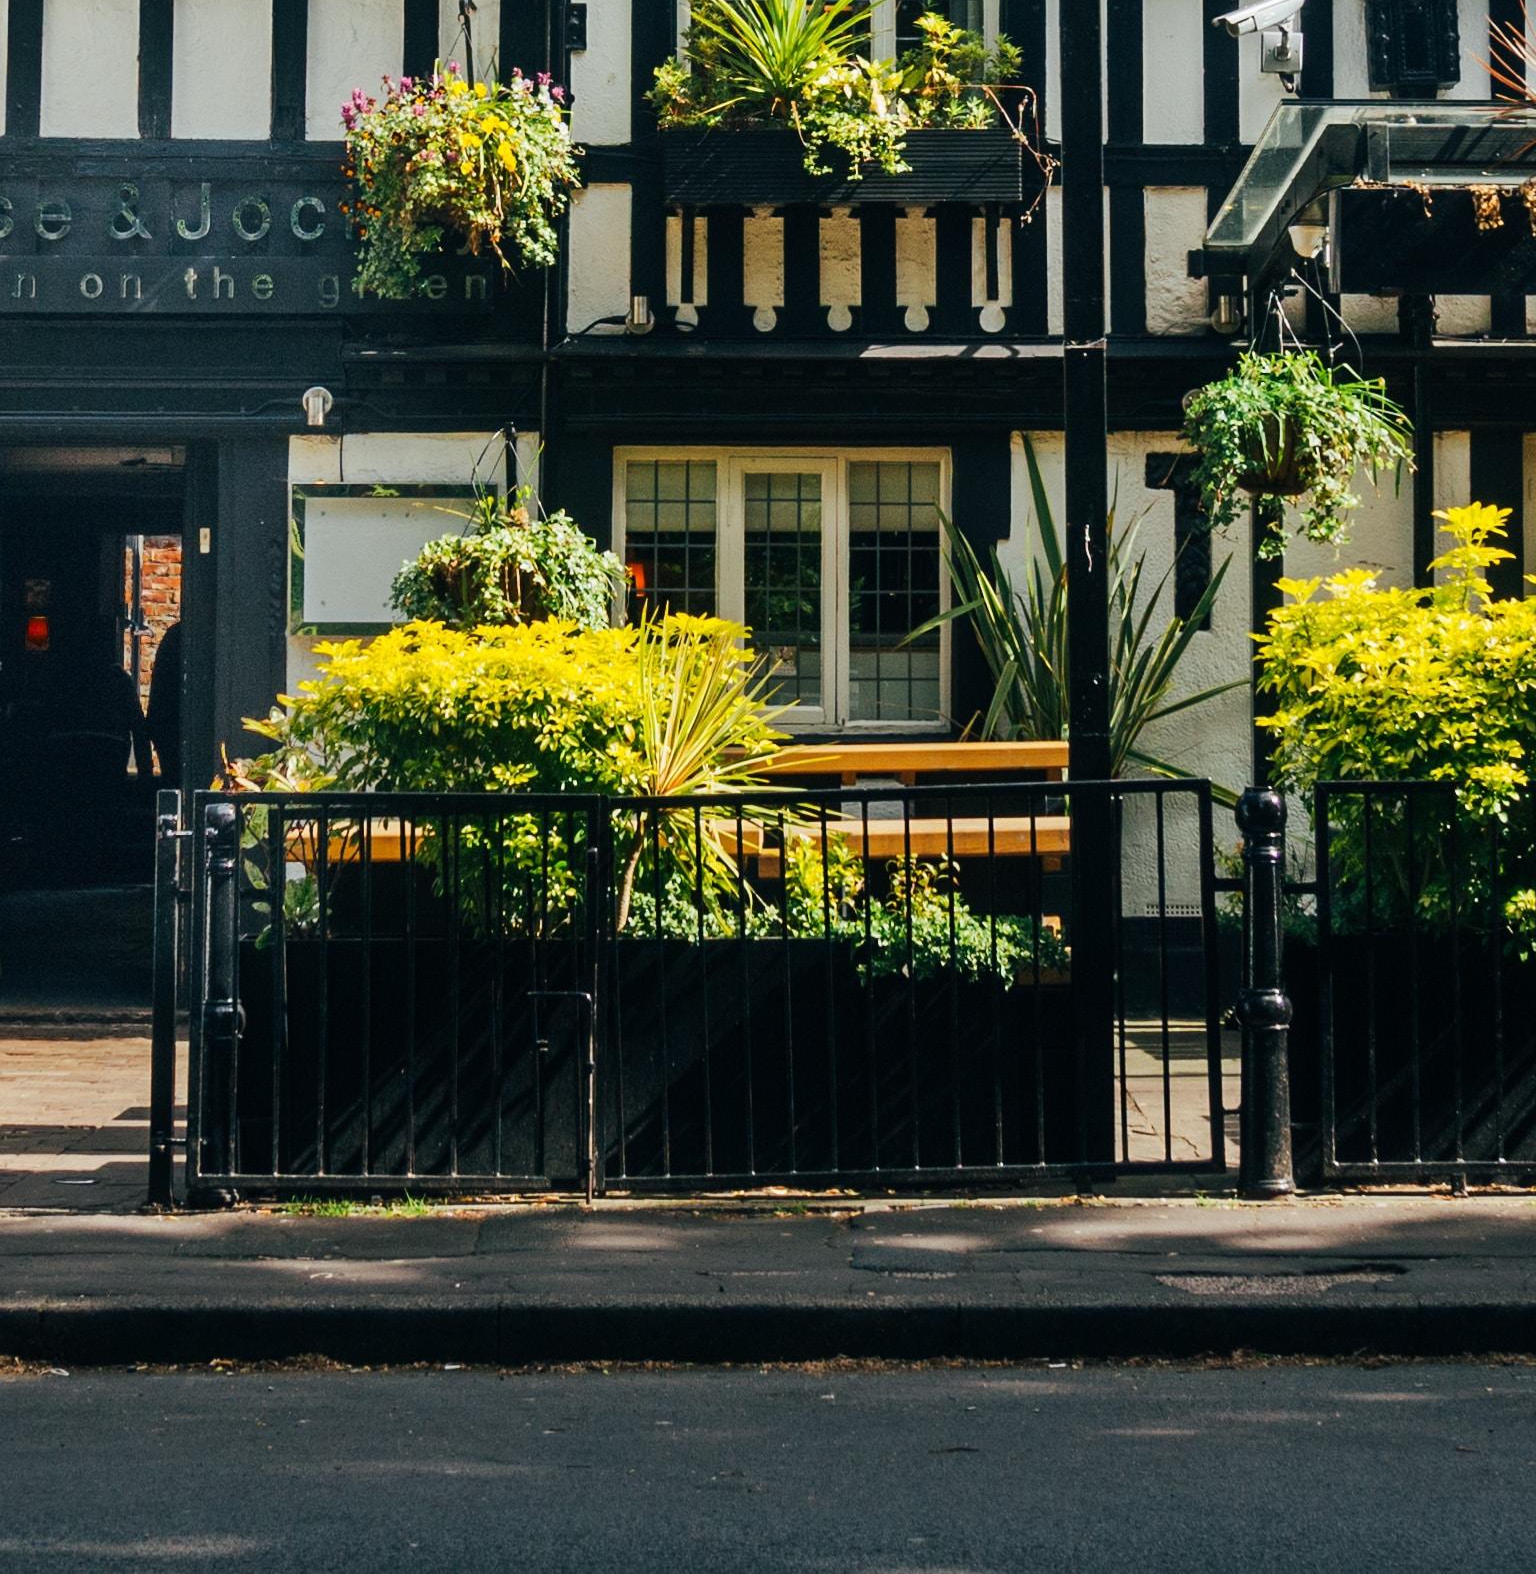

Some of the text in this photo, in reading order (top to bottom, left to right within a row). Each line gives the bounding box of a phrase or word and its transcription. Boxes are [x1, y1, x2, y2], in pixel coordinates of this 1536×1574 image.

[110, 181, 153, 240] &
[79, 272, 142, 300] on
[183, 266, 275, 300] the
[319, 273, 486, 309] gen
